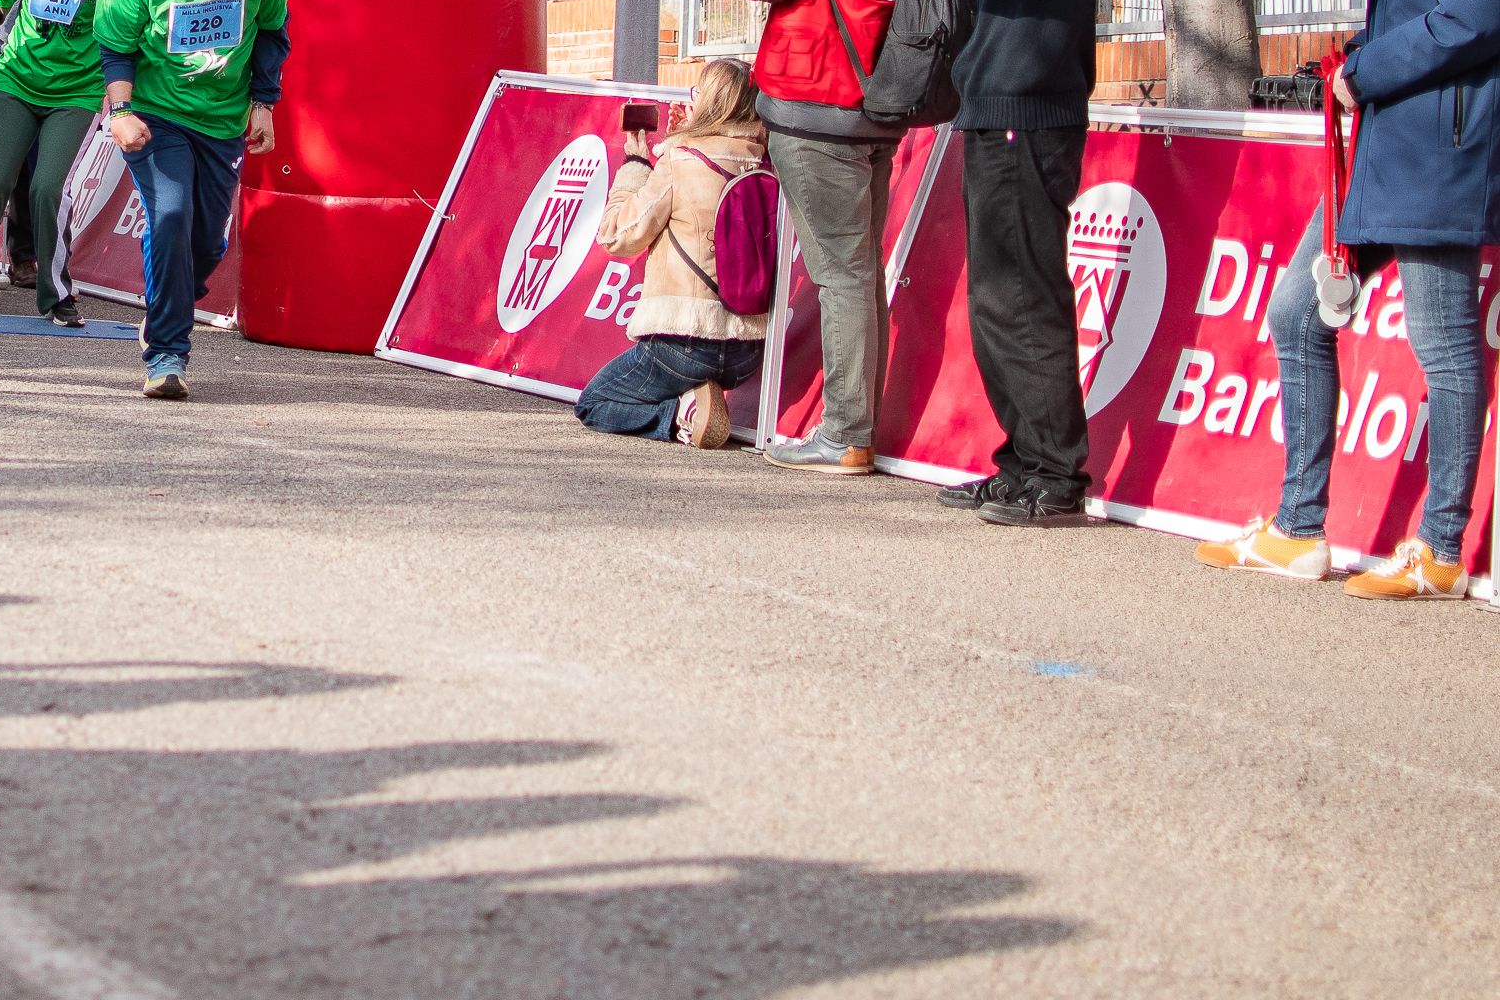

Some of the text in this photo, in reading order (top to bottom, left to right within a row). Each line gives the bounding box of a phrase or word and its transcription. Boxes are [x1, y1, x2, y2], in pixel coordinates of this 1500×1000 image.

[43, 5, 71, 18] ANNA
[202, 4, 233, 14] INCLUSIVA
[189, 15, 223, 33] 220
[180, 31, 231, 46] EDUARD
[111, 101, 124, 110] LOVE
